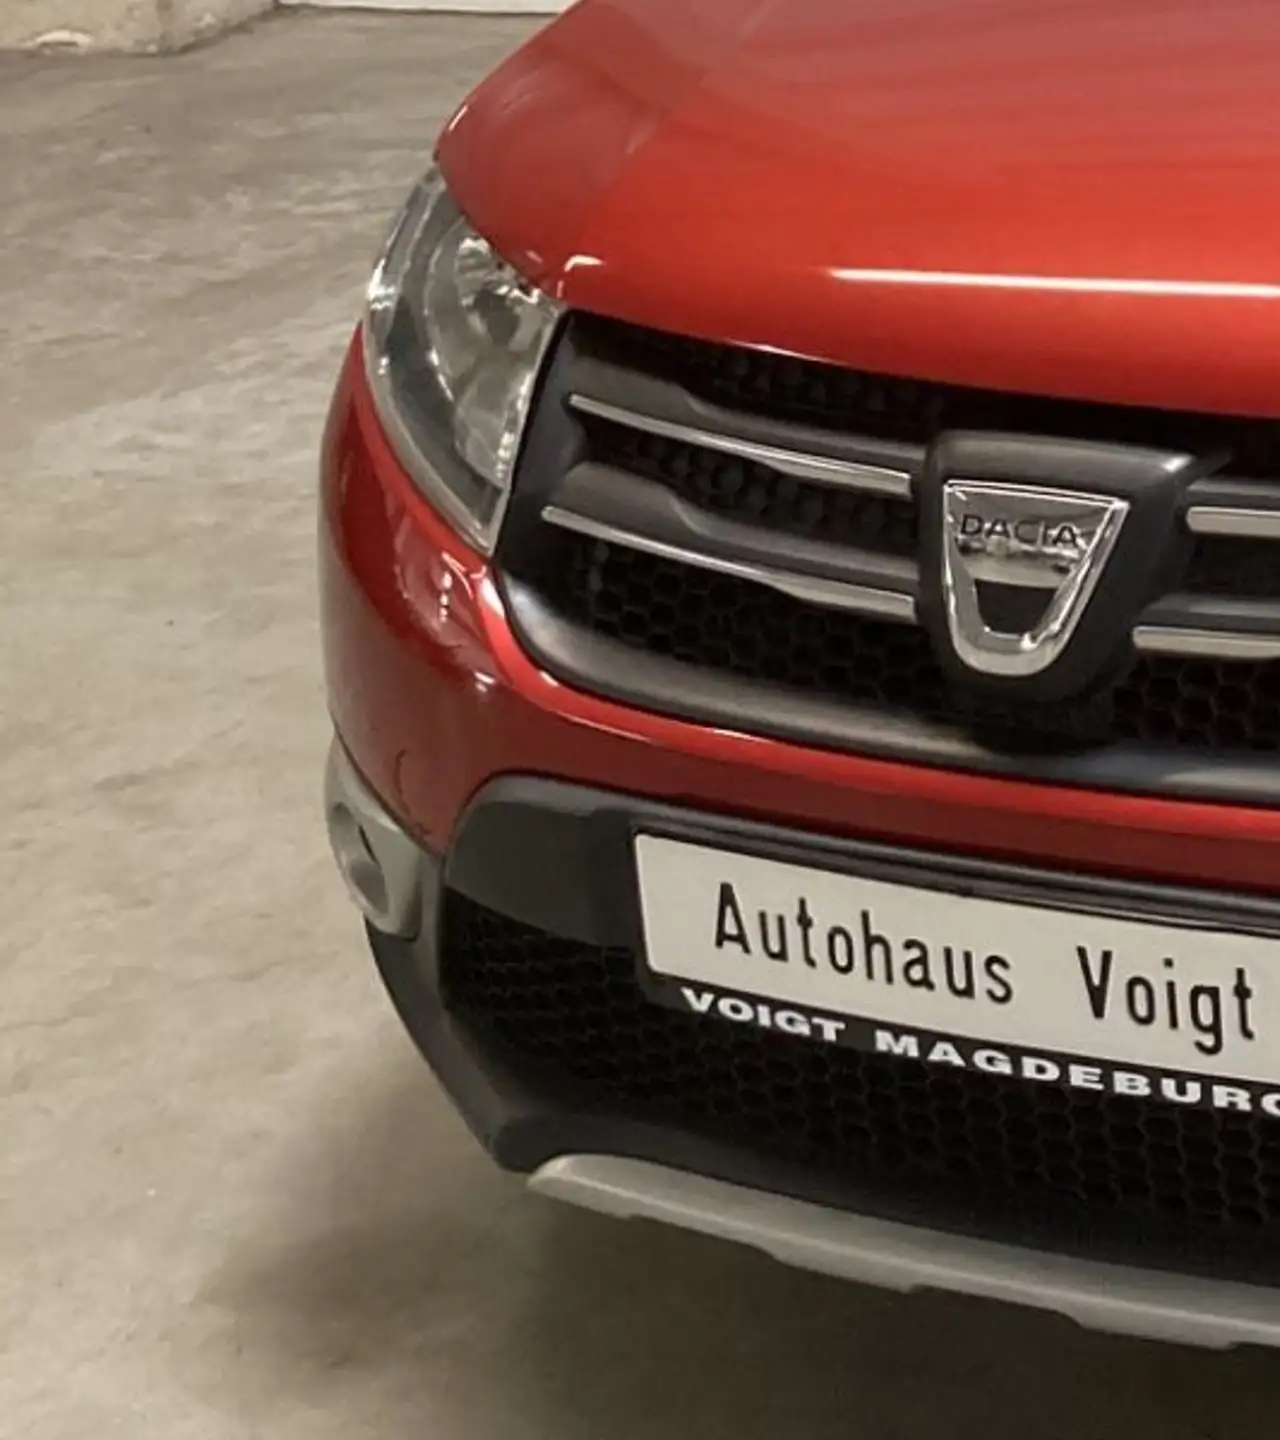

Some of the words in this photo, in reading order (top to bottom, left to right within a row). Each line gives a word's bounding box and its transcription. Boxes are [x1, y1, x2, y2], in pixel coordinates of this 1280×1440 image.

[960, 514, 1078, 546] DACIA
[714, 882, 1014, 1005] Autohaus
[1077, 945, 1255, 1055] Voigt
[681, 986, 845, 1043] VOIGT
